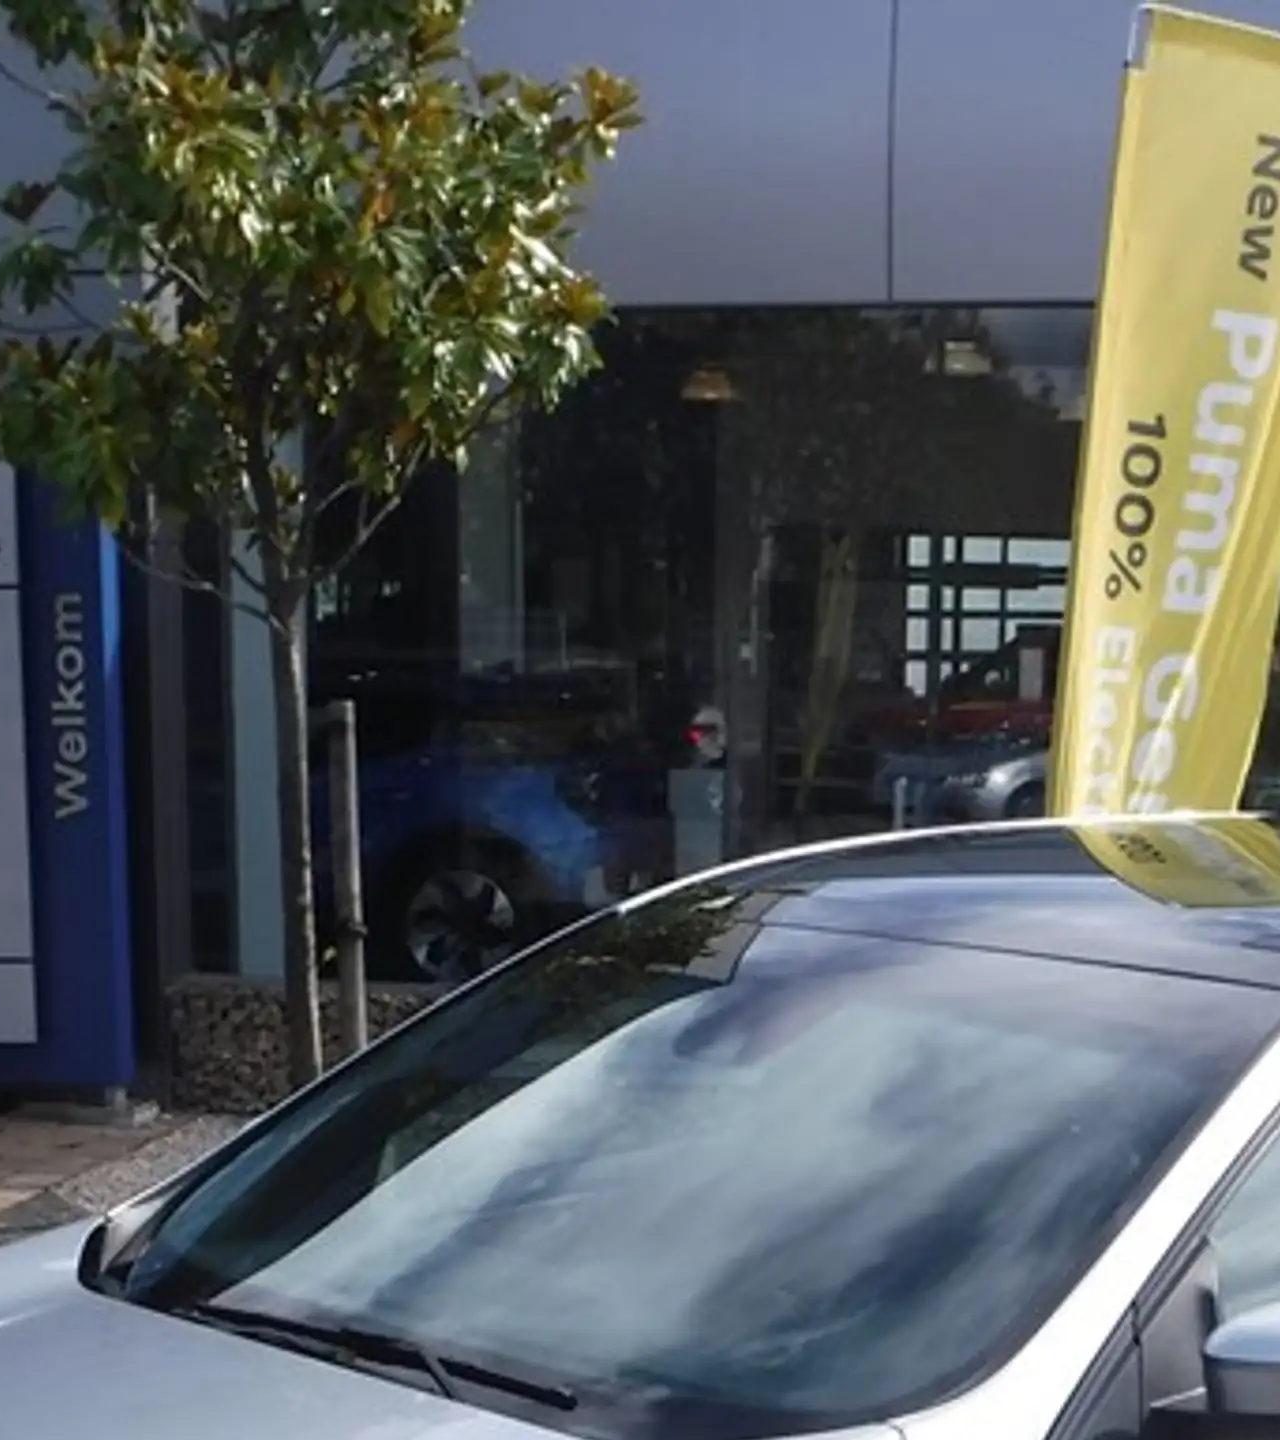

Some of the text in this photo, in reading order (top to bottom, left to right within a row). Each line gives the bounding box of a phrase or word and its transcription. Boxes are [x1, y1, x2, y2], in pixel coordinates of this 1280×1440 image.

[1104, 412, 1167, 601] 100%
[1160, 309, 1280, 614] Puma
[52, 593, 88, 818] Welkom
